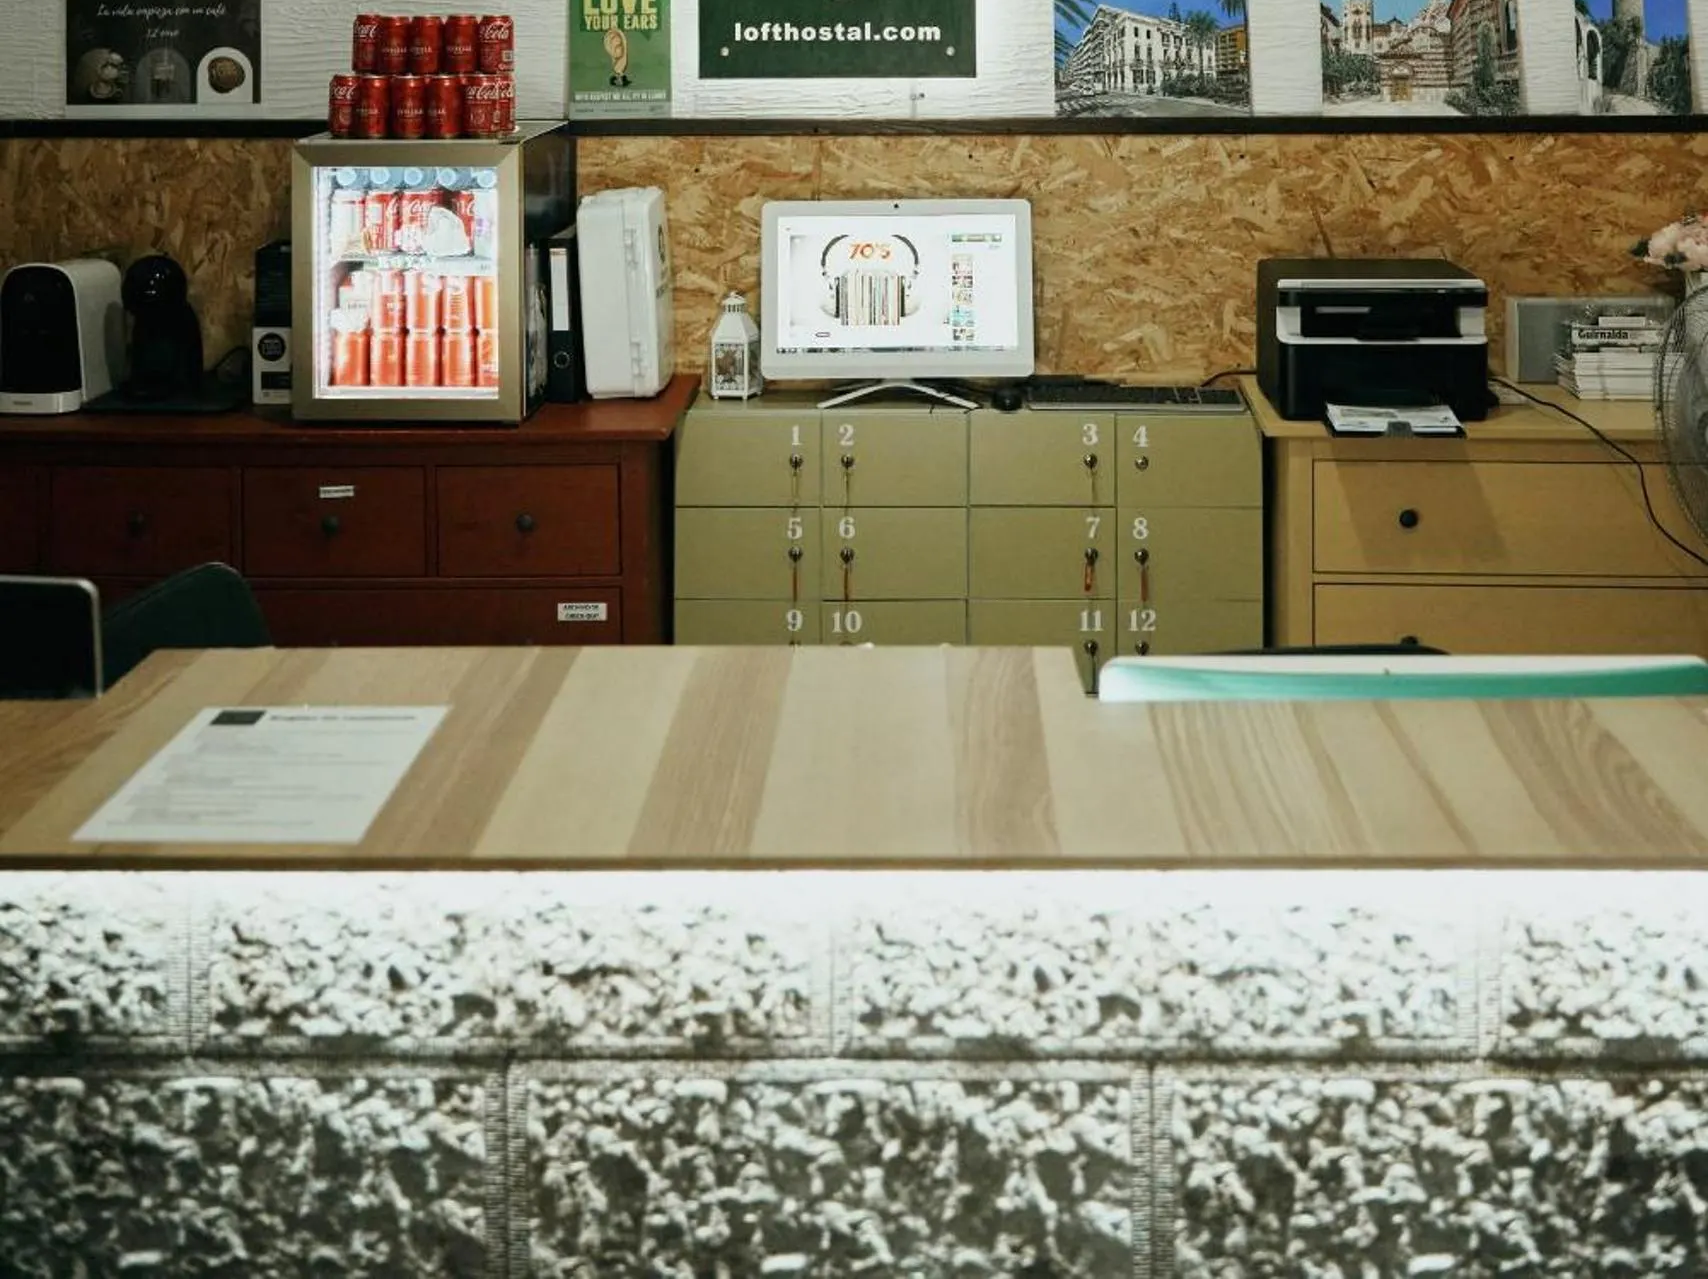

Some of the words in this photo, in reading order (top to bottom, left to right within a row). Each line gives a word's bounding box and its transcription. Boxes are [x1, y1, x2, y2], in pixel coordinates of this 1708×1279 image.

[584, 14, 618, 30] YOUR
[624, 14, 657, 30] EARS
[734, 22, 941, 41] lofthostal.com
[791, 424, 803, 446] 1
[839, 423, 855, 446] 2
[1082, 423, 1098, 445] 3
[1132, 425, 1149, 448] 4
[787, 517, 803, 539] 5
[839, 516, 856, 539] 6
[1085, 517, 1101, 539] 7
[1132, 517, 1149, 540] 8
[787, 609, 803, 632] 9
[831, 610, 863, 633] 10
[1080, 610, 1104, 632] 11
[1128, 609, 1156, 632] 12
